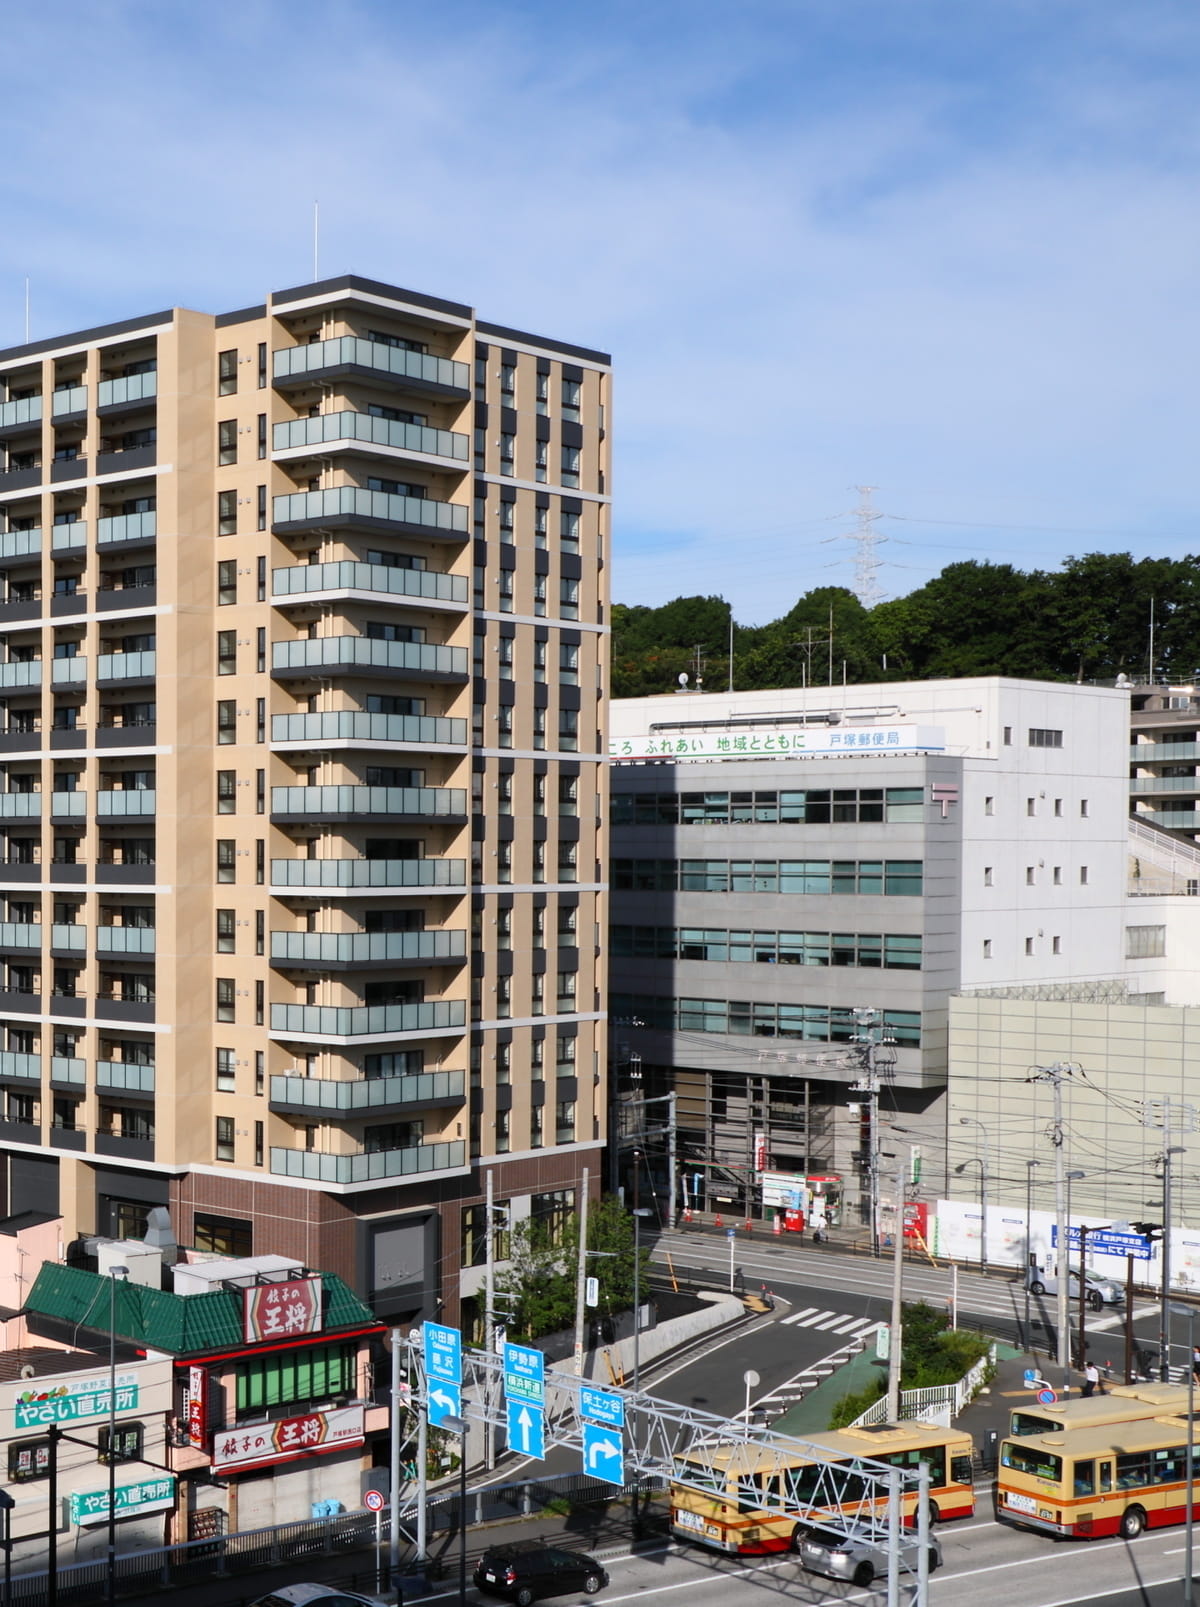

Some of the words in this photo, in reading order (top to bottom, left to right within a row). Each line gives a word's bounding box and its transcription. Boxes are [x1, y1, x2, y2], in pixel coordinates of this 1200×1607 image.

[645, 738, 704, 754] ふれあい
[717, 734, 806, 750] 地域とともに
[829, 732, 900, 747] 戸塚郵便局
[263, 1302, 307, 1336] 王将
[428, 1329, 456, 1346] 小田原
[508, 1349, 539, 1369] 伊勢原
[508, 1375, 541, 1394] 横浜新道
[19, 1388, 134, 1425] やさい直売所
[222, 1436, 266, 1456] 餃子の
[281, 1418, 321, 1448] 王将
[85, 1481, 171, 1512] やさい直売所
